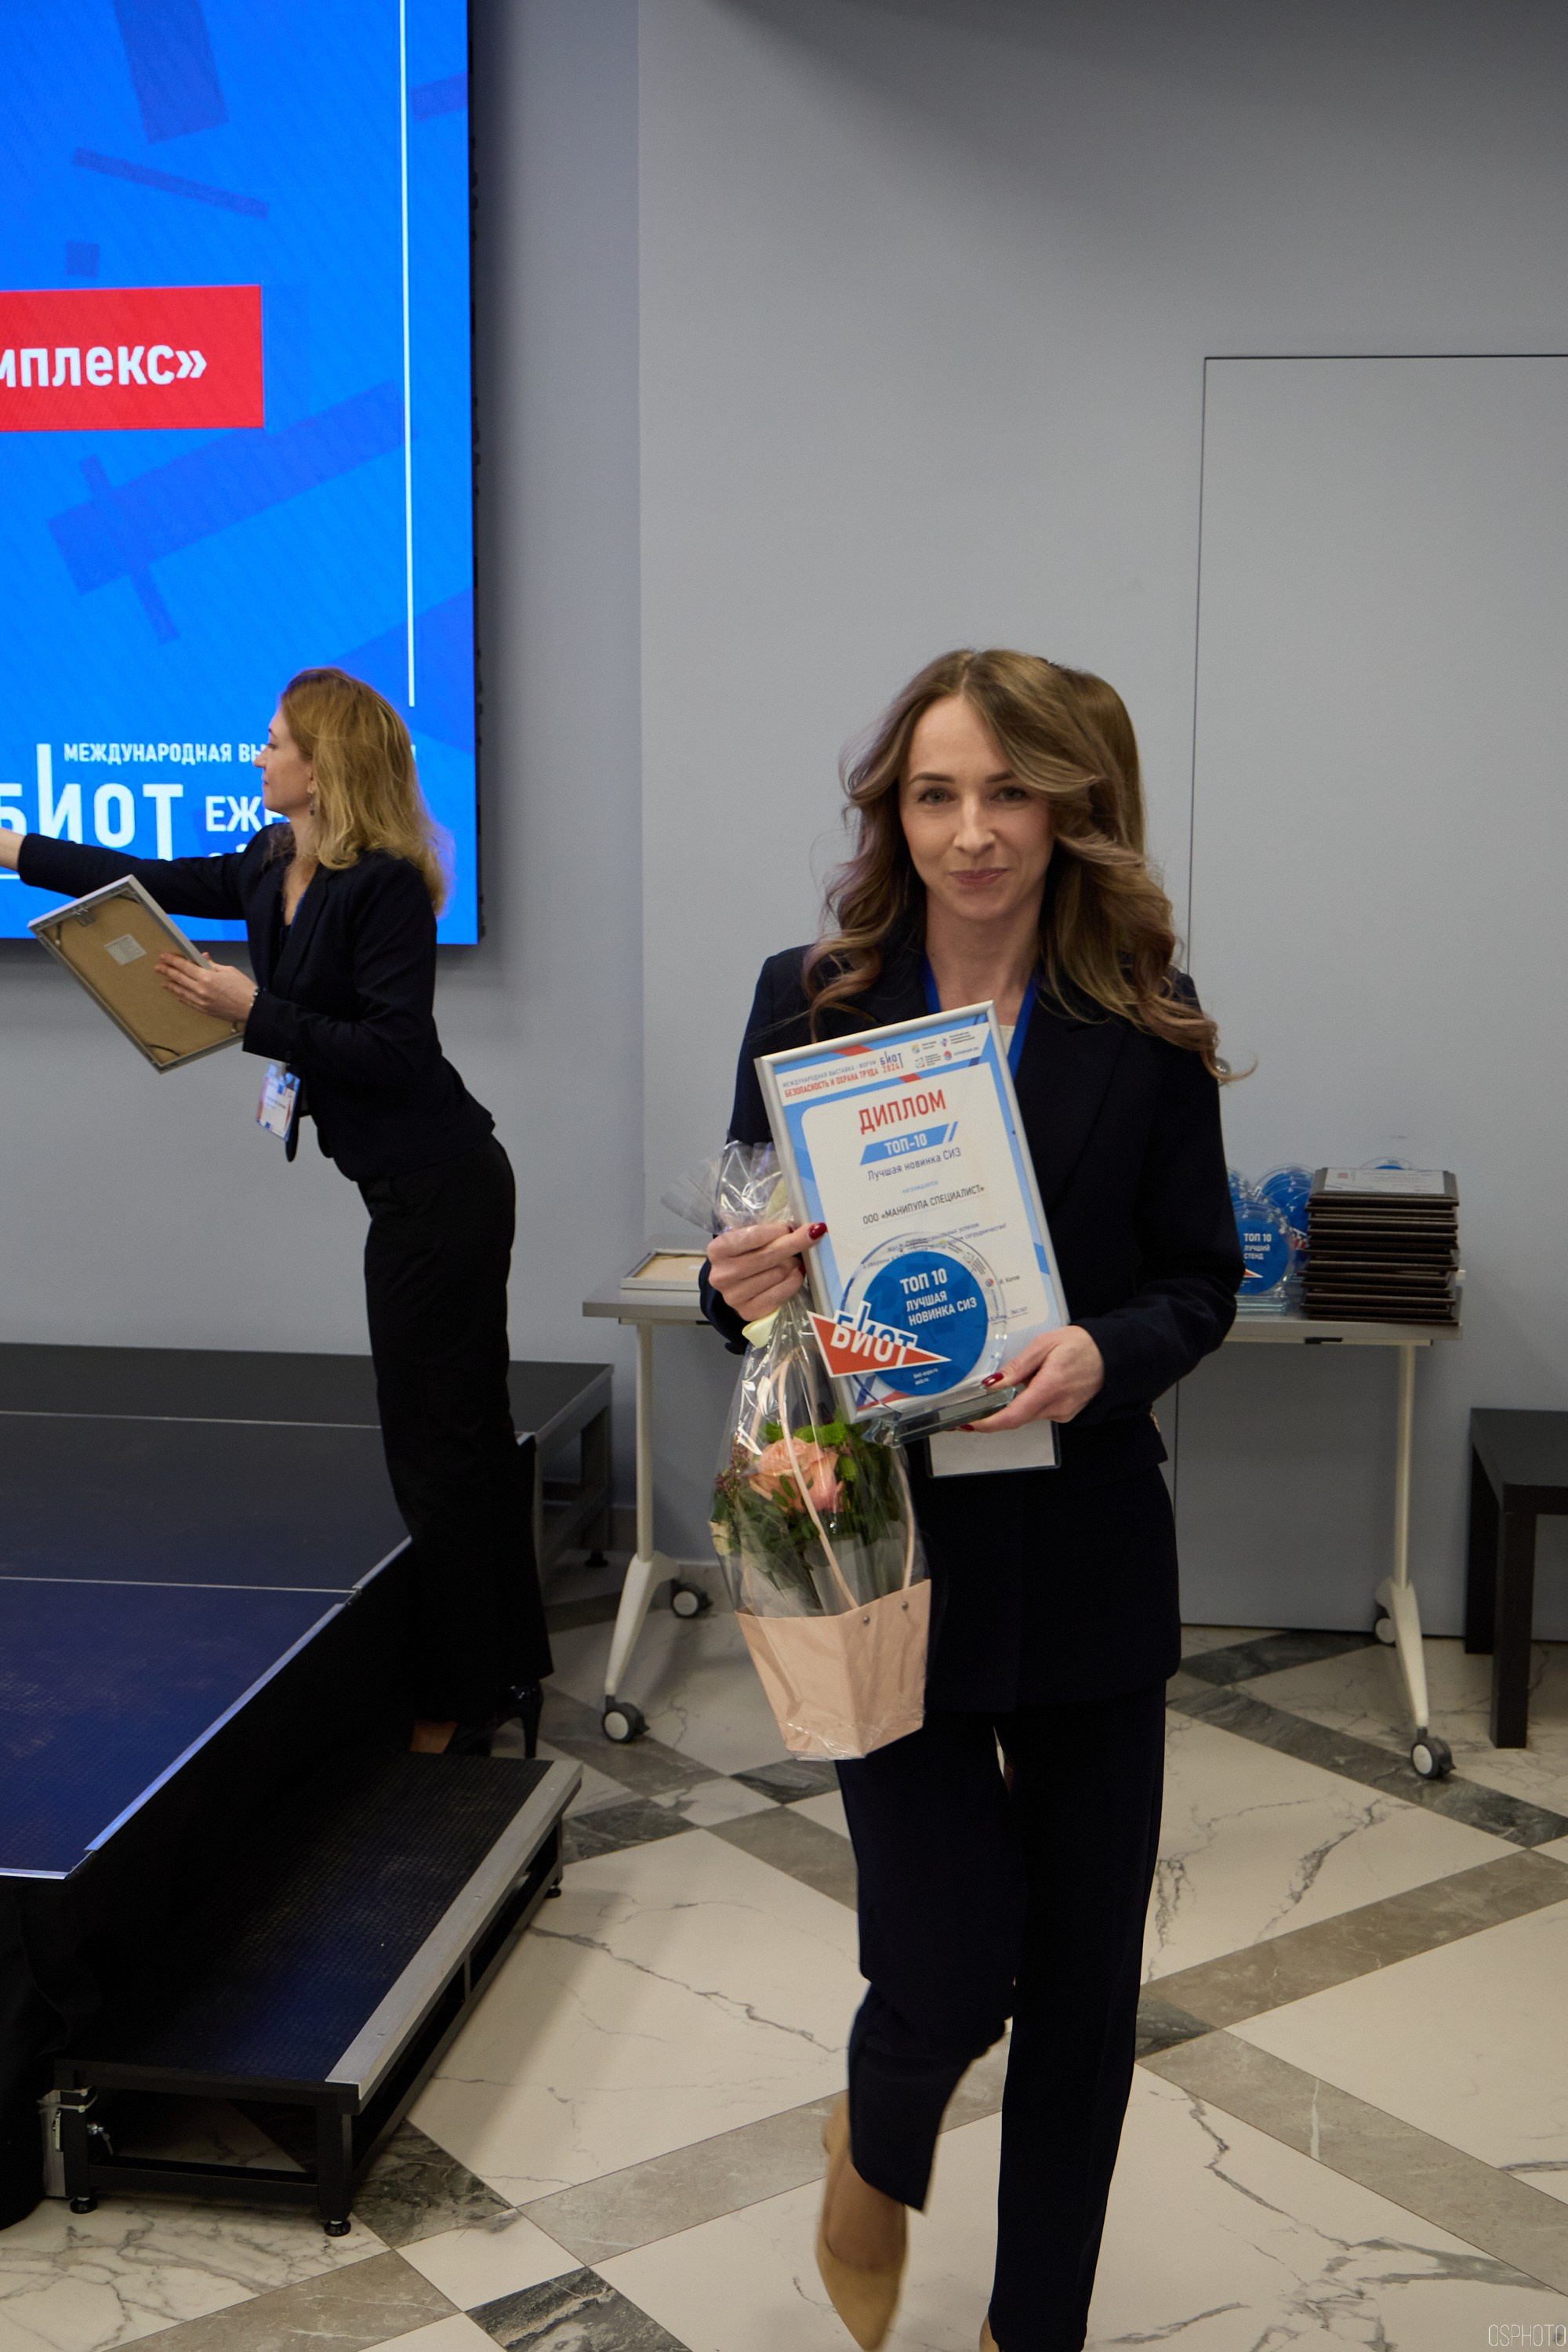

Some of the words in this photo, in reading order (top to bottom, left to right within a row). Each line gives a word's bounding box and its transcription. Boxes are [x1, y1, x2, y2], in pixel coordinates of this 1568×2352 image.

[64, 742, 232, 765] МЕЖДУНАРОДНАЯ
[880, 1051, 904, 1069] БИОТ
[782, 1072, 828, 1087] МЕЖДУНАРОДНАЯ
[829, 1065, 855, 1078] ВЫСТАВКА
[784, 1080, 829, 1098] БЕЗОПАСНОСТЬ
[836, 1073, 858, 1084] ОХРАНА
[859, 1068, 879, 1079] ТРУДА
[883, 1062, 900, 1073] 2024
[858, 1089, 946, 1135] ДИПЛОМ
[884, 1133, 927, 1156] ТОП-10
[867, 1163, 902, 1181] Лучшая
[905, 1155, 942, 1171] новинка
[943, 1147, 961, 1161] СИЗ
[862, 1212, 879, 1225] ООО
[881, 1199, 929, 1219] «МАНИПУЛА
[930, 1184, 985, 1206] СПЕЦИАЛИСТ»
[1243, 1233, 1261, 1242] ТОП
[1262, 1233, 1272, 1242] 10
[900, 1272, 930, 1294] ТОП
[931, 1268, 948, 1285] 10
[906, 1290, 948, 1312] ЛУЧШАЯ
[908, 1306, 956, 1327] НОВИНКА
[957, 1296, 978, 1312] СИЗ
[830, 1304, 916, 1367] БИОТ
